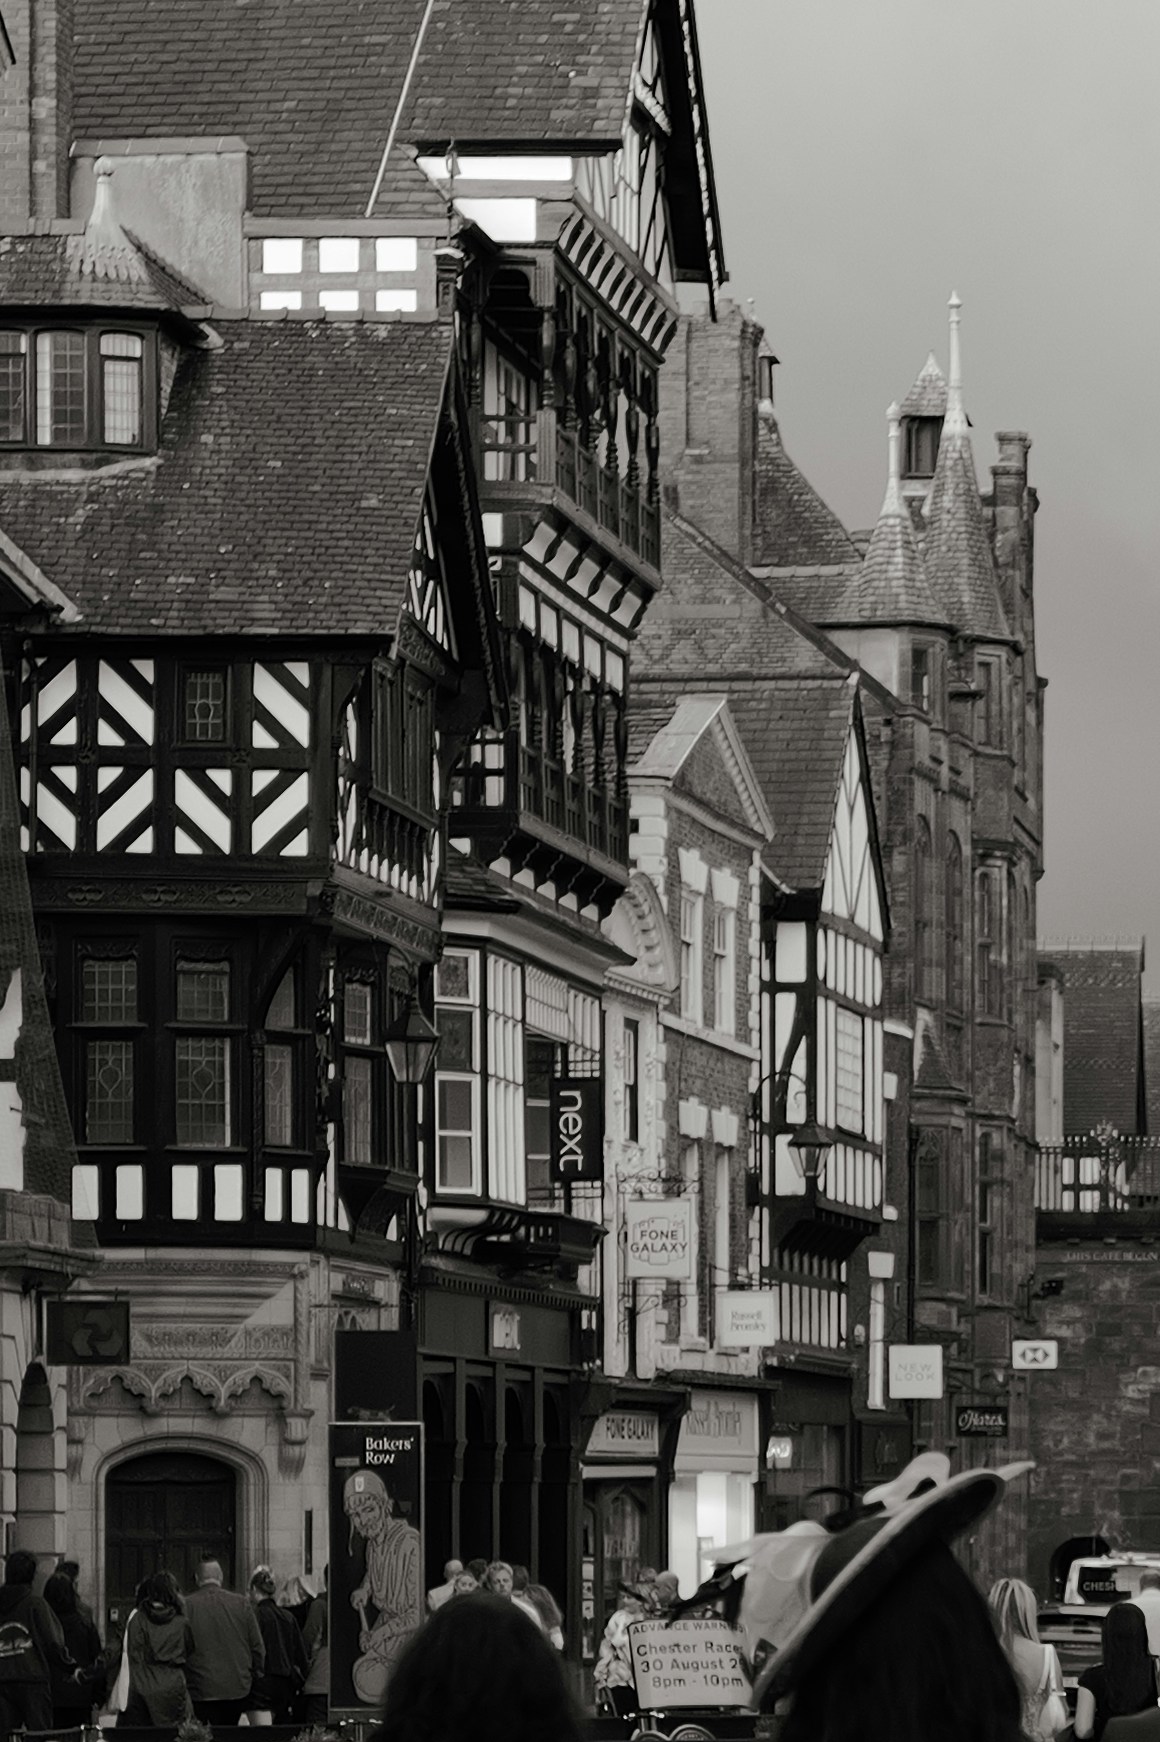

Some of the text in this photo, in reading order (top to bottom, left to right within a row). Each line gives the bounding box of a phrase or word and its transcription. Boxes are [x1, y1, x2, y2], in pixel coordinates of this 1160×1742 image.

[559, 1090, 584, 1172] next
[640, 1230, 678, 1240] FONE
[630, 1243, 688, 1253] GALAXY
[898, 1363, 932, 1372] NEW
[895, 1372, 935, 1382] LOOK
[606, 1417, 655, 1440] FONE GALAXY
[365, 1451, 395, 1465] Row
[692, 1622, 744, 1634] WARNG
[636, 1642, 697, 1657] Chester
[641, 1660, 663, 1673] 30
[671, 1658, 724, 1673] August
[652, 1676, 686, 1689] 8pm
[703, 1675, 744, 1688] 10pm
